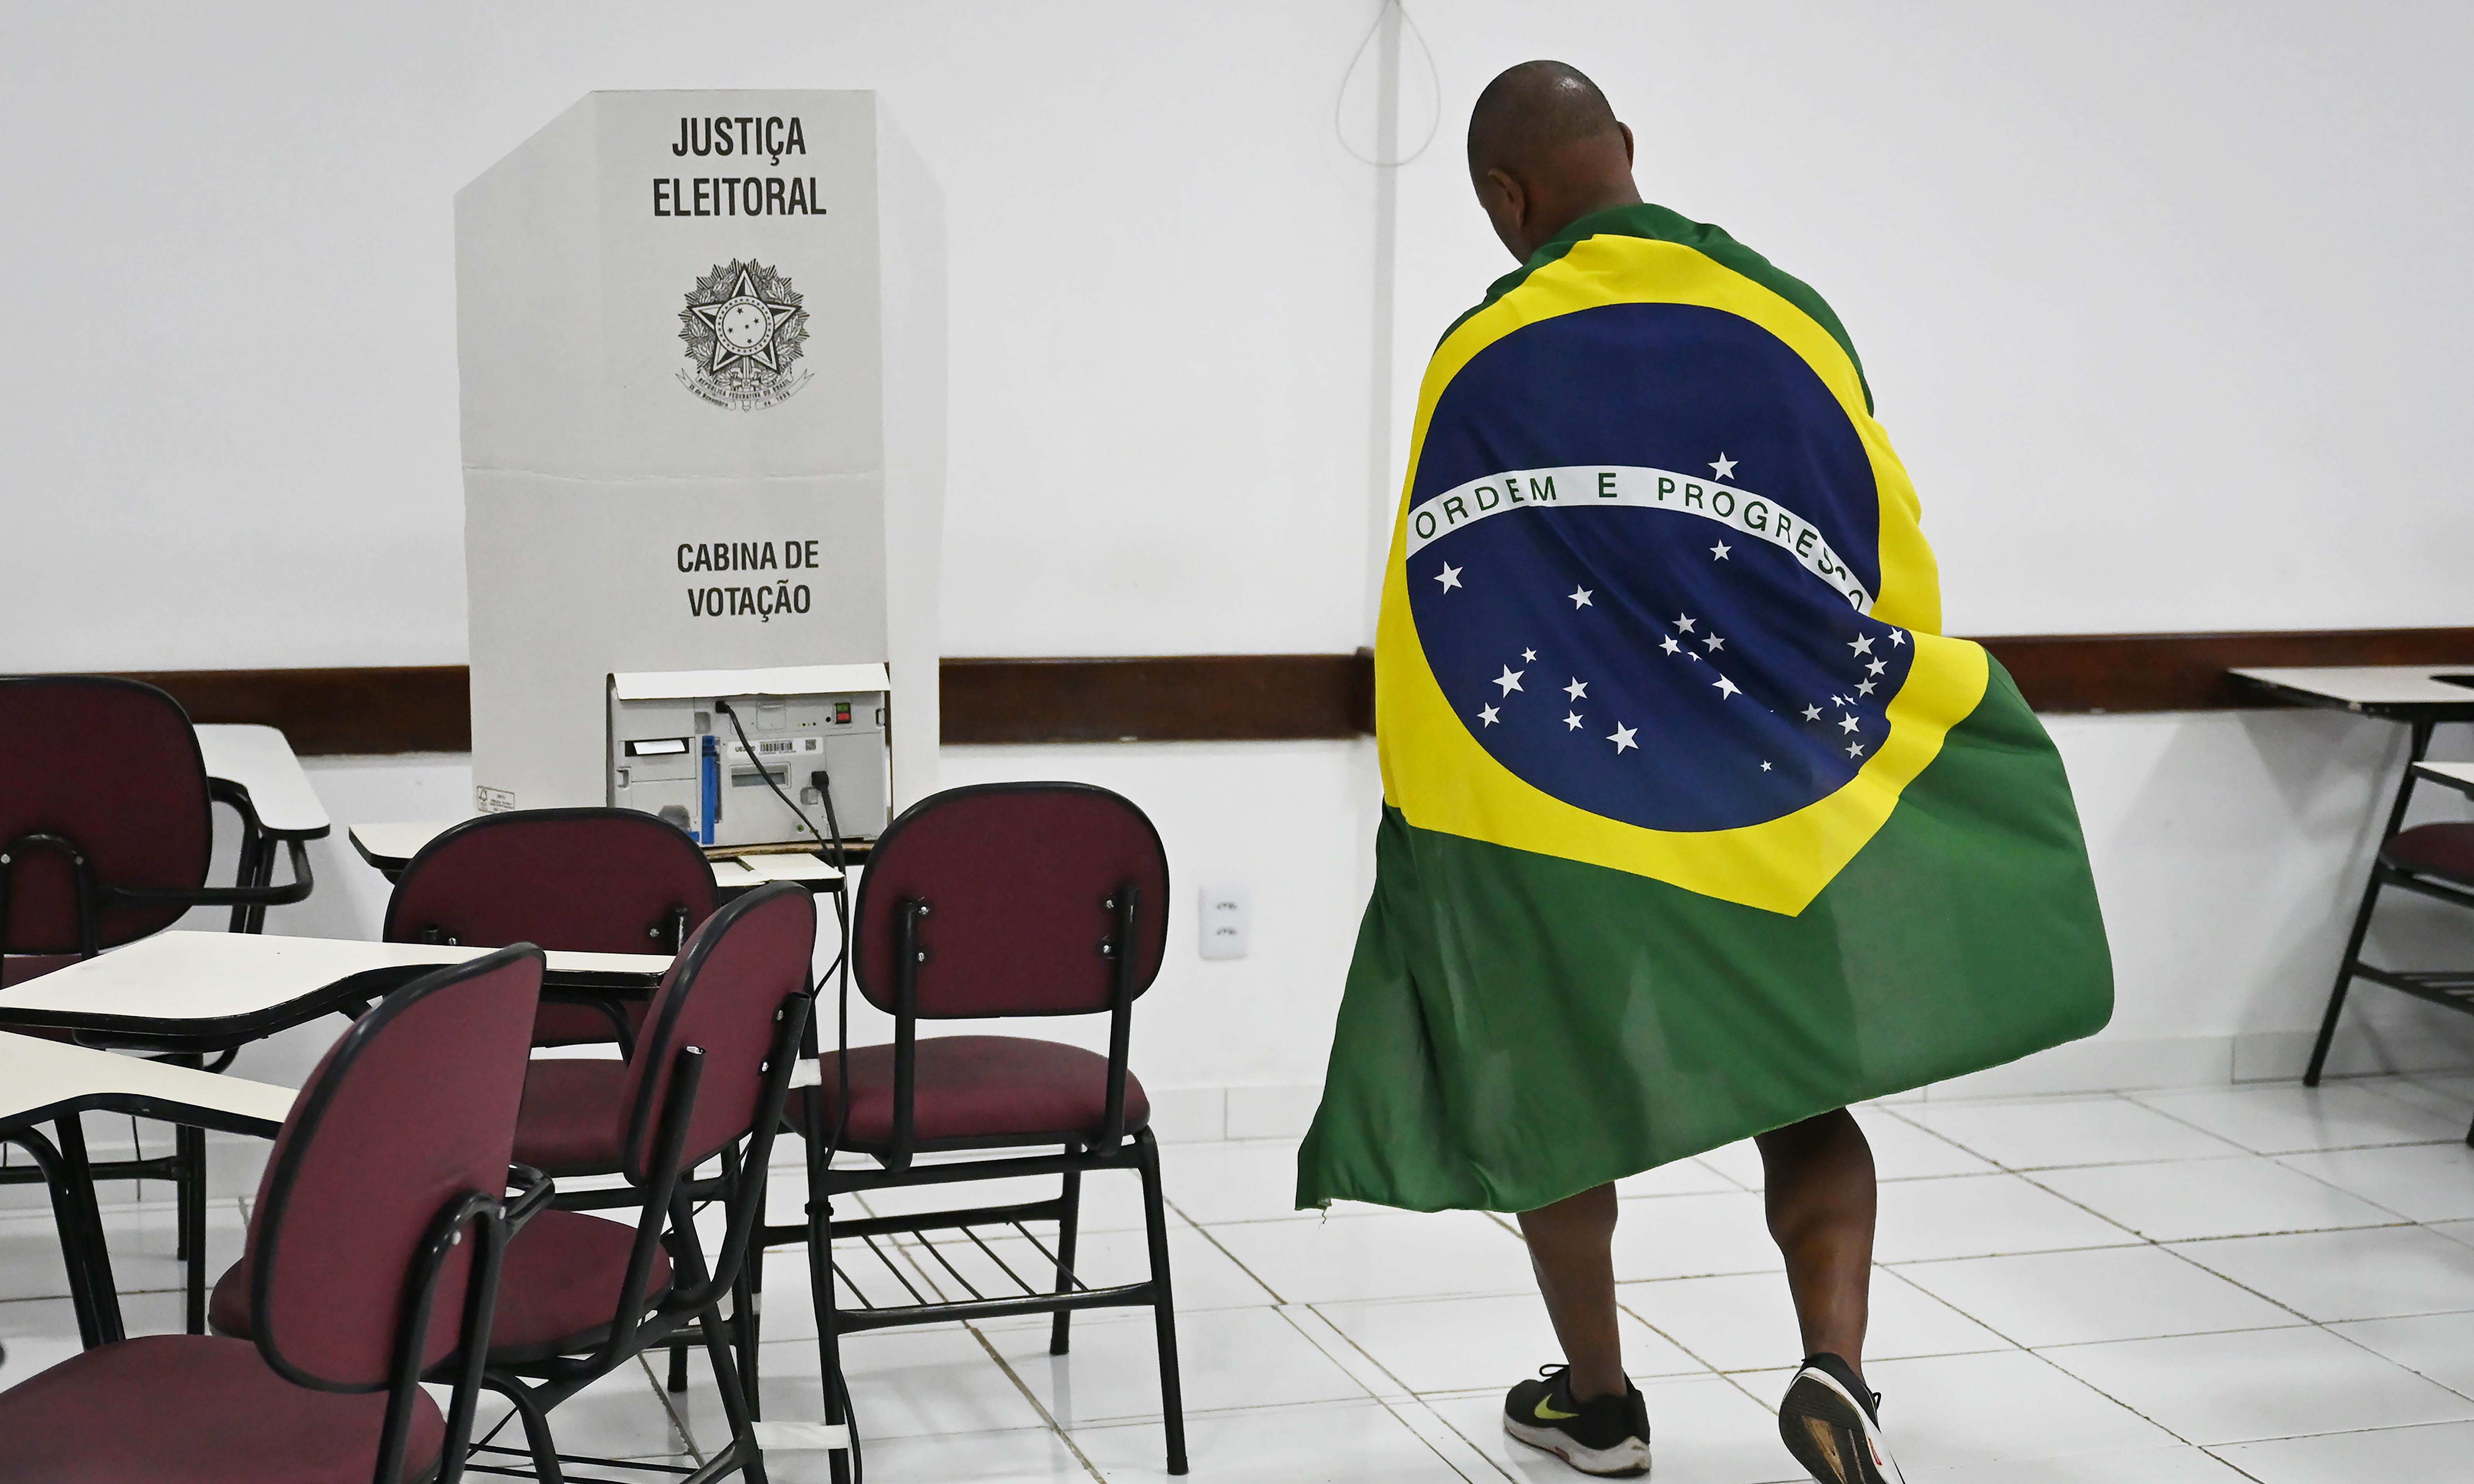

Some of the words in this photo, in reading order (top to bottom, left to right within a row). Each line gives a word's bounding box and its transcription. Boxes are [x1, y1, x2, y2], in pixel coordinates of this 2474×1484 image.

[672, 117, 806, 166] JUSTIÇA
[653, 177, 826, 216] ELEITORAL
[1416, 476, 1556, 539] ORDEM
[1598, 472, 1617, 498] E
[678, 542, 778, 572] CABINA
[786, 540, 819, 568] DE
[688, 579, 811, 623] VOTAÇÃO
